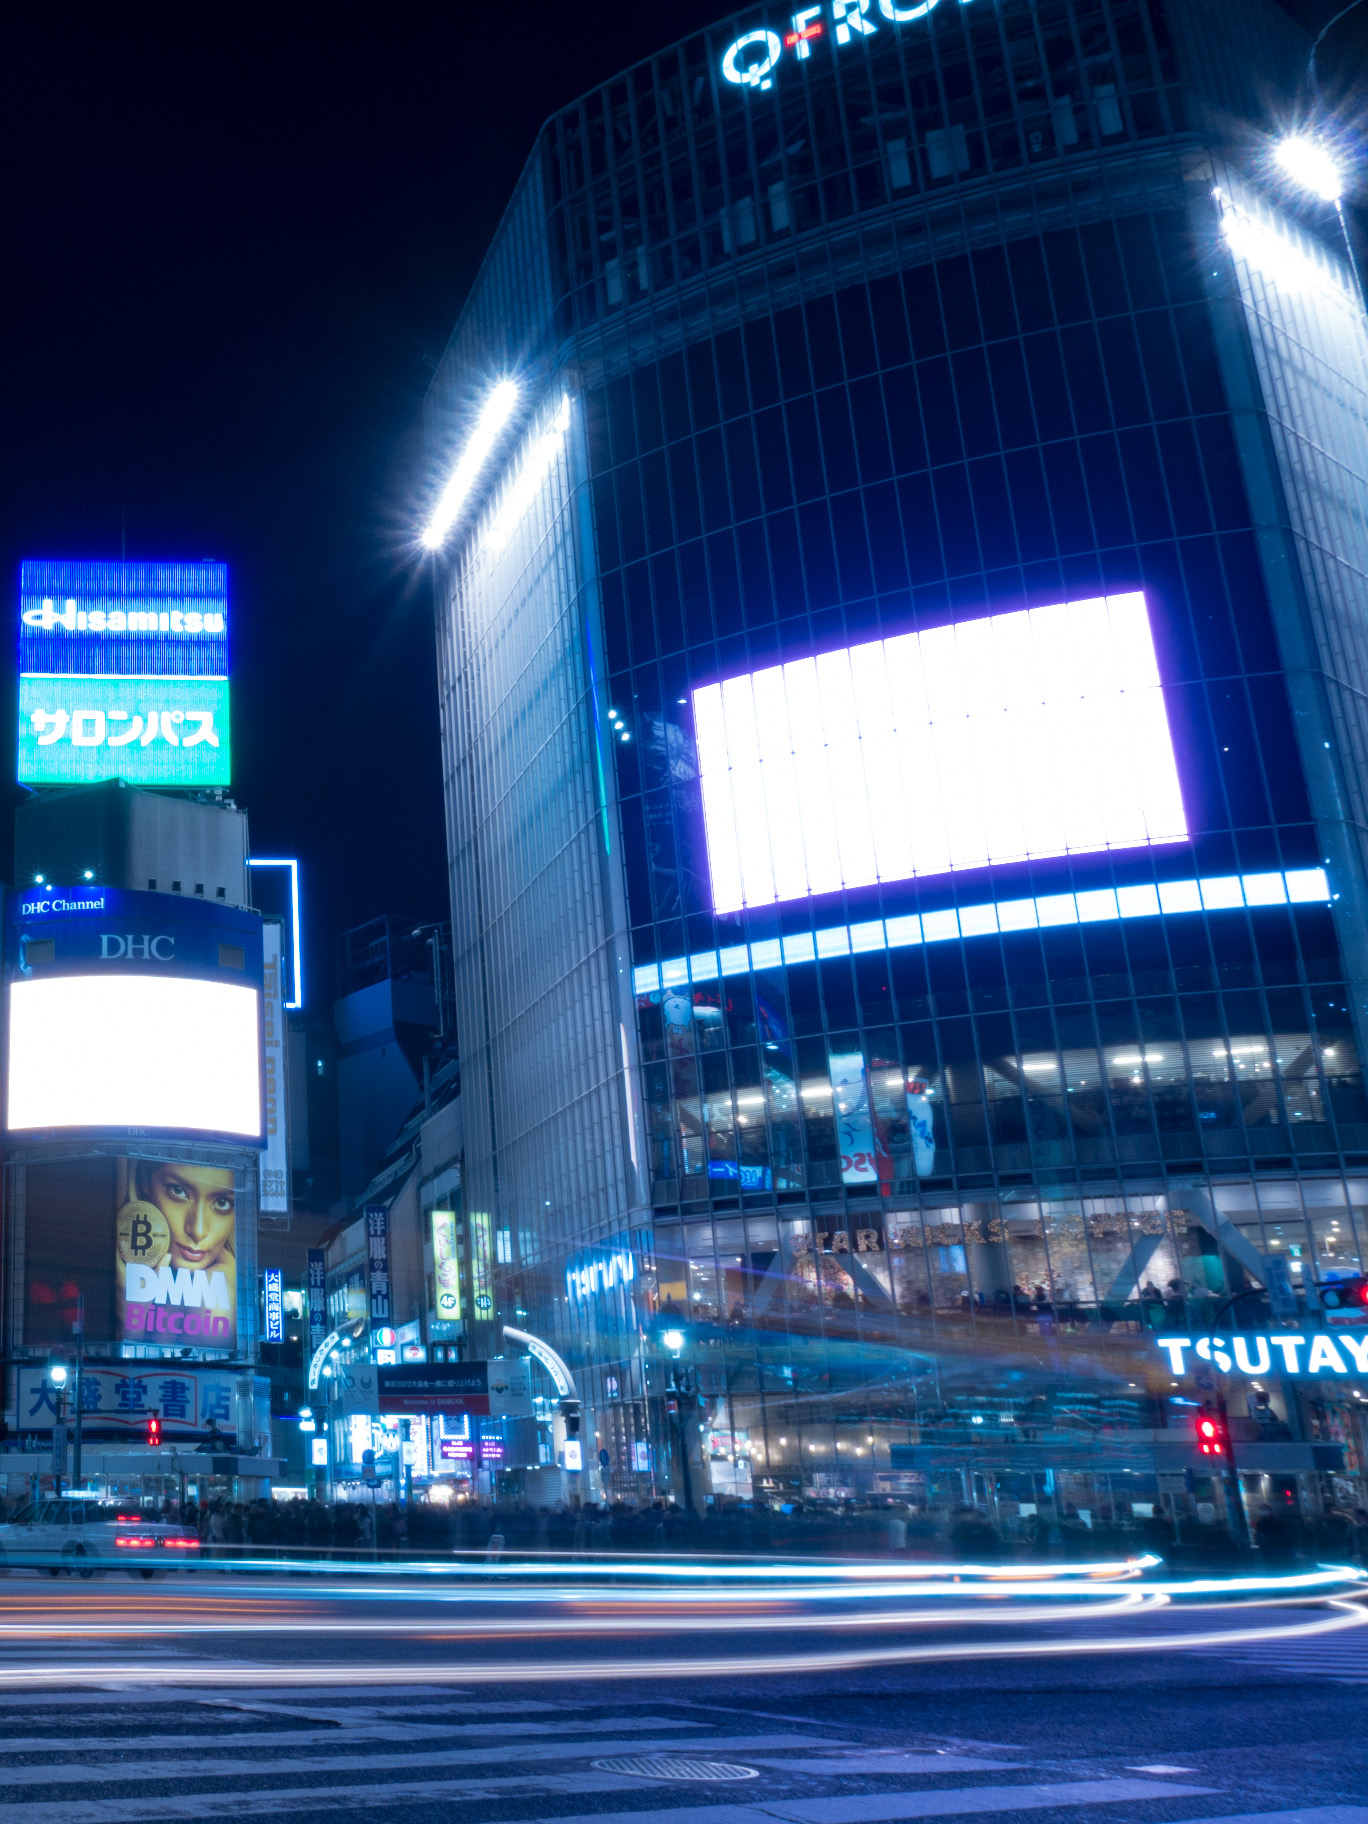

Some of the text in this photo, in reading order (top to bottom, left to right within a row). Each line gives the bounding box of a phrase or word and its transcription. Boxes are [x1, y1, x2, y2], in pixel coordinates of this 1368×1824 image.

[722, 0, 975, 90] QFR
[22, 599, 224, 634] Hisamitsu
[31, 707, 220, 748] サロンパス
[21, 897, 105, 915] DHC Channel
[100, 934, 176, 962] DHC
[790, 1208, 1189, 1257] STARBUCKS COFFEE
[125, 1262, 230, 1310] DMM
[368, 1212, 390, 1319] 洋服の青山
[125, 1303, 230, 1338] Bitcoin
[267, 1272, 280, 1341] 大盛堂商事ビル
[440, 1295, 455, 1308] 4F
[29, 1376, 232, 1422] 大盛堂書店
